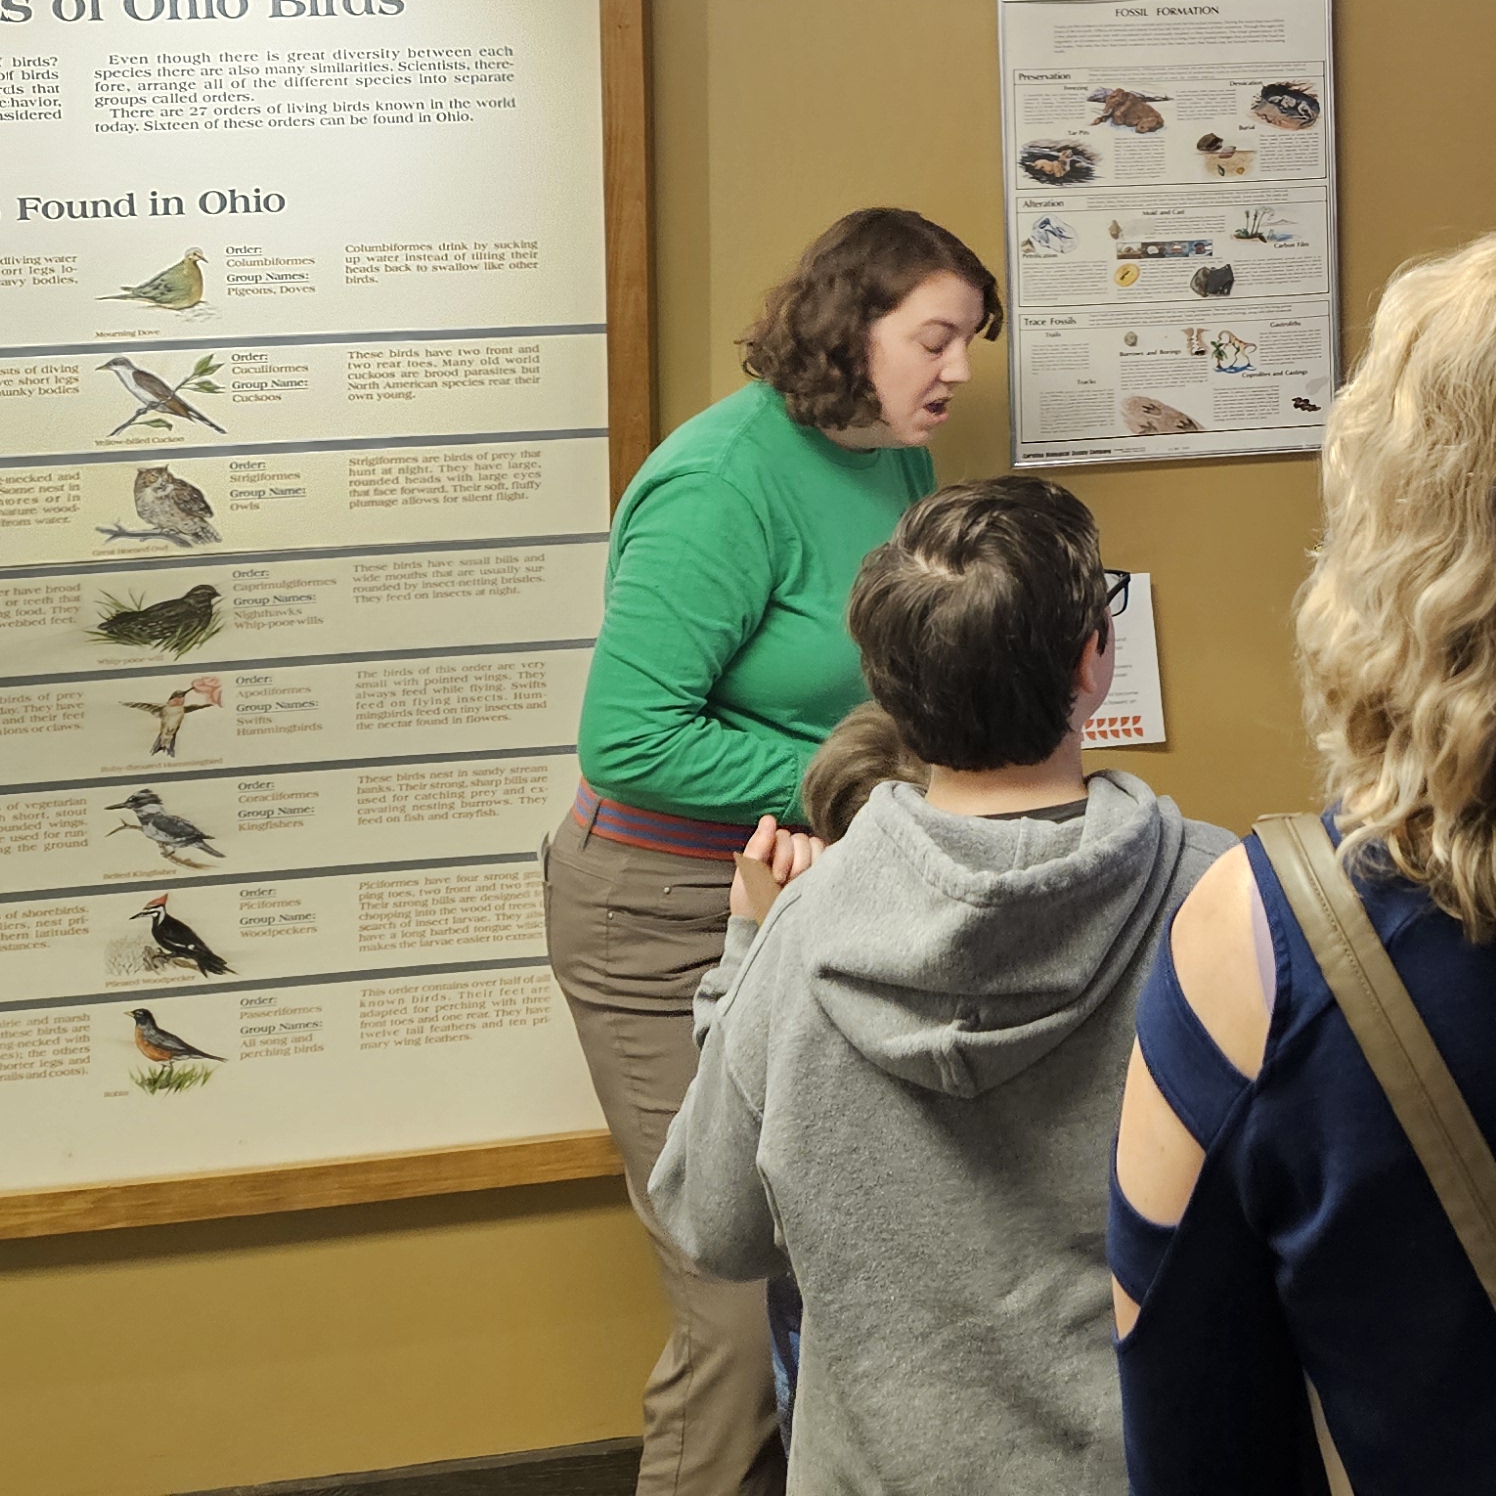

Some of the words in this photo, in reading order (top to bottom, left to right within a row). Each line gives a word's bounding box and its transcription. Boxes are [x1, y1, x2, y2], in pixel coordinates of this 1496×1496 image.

[1115, 8, 1148, 17] FOSSIL
[1156, 6, 1219, 16] FORMATION
[12, 56, 58, 68] birds?
[108, 54, 148, 65] Even
[156, 53, 211, 67] though
[219, 52, 258, 62] there
[266, 51, 279, 62] is
[287, 50, 324, 64] great
[332, 49, 399, 63] diversity
[407, 47, 472, 58] between
[478, 46, 513, 57] each
[21, 70, 59, 80] birds
[93, 67, 152, 81] species
[157, 66, 195, 77] there
[200, 68, 223, 76] are
[228, 65, 260, 75] also
[264, 67, 304, 78] many
[32, 84, 60, 94] that
[137, 82, 196, 94] arrange
[203, 79, 223, 89] all
[230, 78, 245, 89] of
[253, 78, 276, 88] the
[283, 76, 348, 87] different
[355, 74, 412, 89] species
[419, 73, 447, 84] into
[453, 72, 514, 86] separate
[94, 96, 147, 108] groups
[151, 93, 197, 104] called
[202, 92, 254, 103] orders.
[112, 107, 154, 118] There
[159, 109, 184, 117] are
[189, 106, 207, 116] 27
[213, 104, 261, 115] orders
[266, 104, 281, 114] of
[287, 103, 328, 117] living
[332, 102, 370, 113] birds
[375, 100, 425, 111] known
[430, 100, 444, 110] in
[449, 99, 471, 110] the
[476, 98, 516, 109] world
[143, 120, 199, 131] Sixteen
[203, 119, 218, 130] of
[223, 118, 263, 129] these
[267, 116, 315, 128] orders
[319, 118, 345, 126] can
[349, 115, 368, 126] be
[373, 114, 414, 125] found
[418, 113, 432, 124] in
[435, 112, 473, 123] Ohio.
[17, 192, 138, 221] Found
[149, 190, 185, 217] in
[198, 187, 286, 215] Ohio
[225, 246, 263, 255] Order:
[344, 243, 434, 253] Columbiformes
[437, 242, 470, 251] drink
[474, 241, 490, 252] by
[494, 240, 538, 252] sucking
[226, 258, 316, 268] Columbiformes
[344, 257, 361, 265] up
[366, 253, 400, 262] water
[405, 252, 453, 262] instead
[454, 252, 466, 260] of
[471, 251, 506, 262] tilting
[510, 250, 538, 259] their
[345, 264, 380, 273] heads
[383, 263, 412, 272] back
[415, 263, 428, 272] to
[431, 262, 480, 271] swallow
[483, 261, 505, 270] like
[508, 260, 538, 269] other
[226, 274, 262, 284] Group
[265, 272, 309, 281] Names:
[345, 275, 378, 284] birds.
[280, 285, 316, 294] Doves
[231, 354, 268, 362] Order:
[347, 350, 385, 359] These
[388, 349, 420, 358] birds
[424, 348, 455, 357] have
[457, 347, 482, 356] two
[485, 346, 513, 355] front
[517, 345, 539, 354] and
[347, 360, 374, 369] two
[441, 357, 476, 369] Many
[479, 356, 500, 365] old
[504, 355, 540, 364] world
[346, 370, 396, 380] cuckoos
[423, 368, 459, 378] brood
[463, 367, 517, 379] parasites
[520, 366, 540, 375] but
[232, 380, 268, 390] Group
[270, 379, 308, 388] Name:
[232, 394, 282, 402] Cuckoos
[229, 461, 266, 470] Order:
[229, 472, 300, 483] Strigiformes
[230, 489, 265, 499] Group
[269, 487, 306, 496] Name:
[230, 502, 260, 511] Owls
[232, 570, 269, 578] Order:
[233, 597, 269, 607] Group
[272, 594, 316, 603] Names:
[234, 608, 302, 620] Nighthawks
[236, 676, 273, 685] Order:
[236, 686, 311, 699] Apodiformes
[236, 703, 272, 713] Group
[275, 700, 319, 709] Names:
[237, 716, 272, 726] Swifts
[237, 723, 323, 736] Hummingbirds
[237, 782, 275, 791] Order:
[237, 810, 274, 819] Group
[277, 806, 315, 815] Name:
[238, 820, 304, 832] Kingfishers
[240, 889, 276, 897] Order:
[239, 899, 301, 911] Piciformes
[240, 916, 275, 926] Group
[279, 913, 316, 922] Name:
[240, 925, 318, 938] Woodpeckers
[240, 997, 277, 1006] Order:
[240, 1006, 322, 1020] Passeriformes
[240, 1025, 276, 1035] Group
[279, 1021, 323, 1031] Names:
[240, 1039, 256, 1049] All
[260, 1038, 288, 1047] song
[291, 1034, 313, 1043] and
[240, 1048, 291, 1061] perching
[294, 1044, 324, 1054] birds
